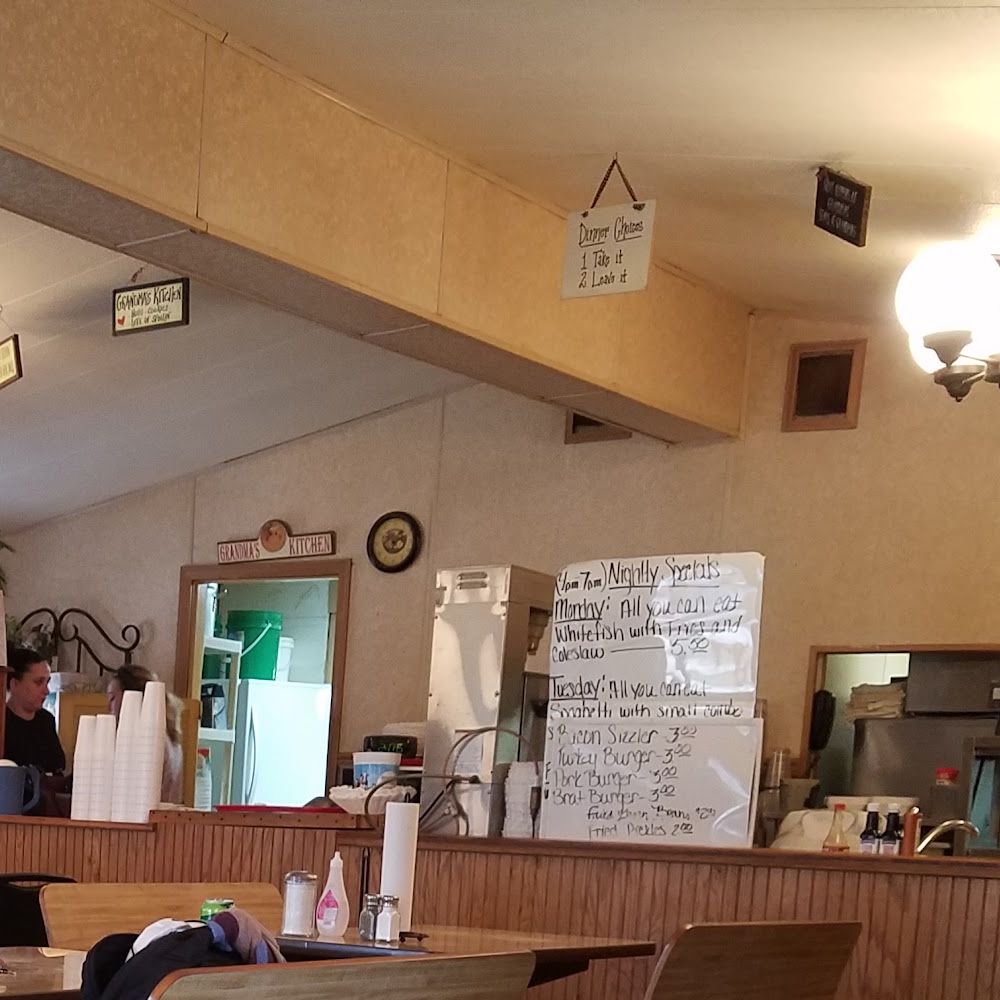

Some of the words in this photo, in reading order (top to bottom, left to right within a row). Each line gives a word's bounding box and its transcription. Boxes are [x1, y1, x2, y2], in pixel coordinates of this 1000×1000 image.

[579, 222, 609, 245] Dinner
[614, 216, 643, 241] Choices
[581, 252, 587, 270] 1
[593, 249, 610, 267] Take
[616, 249, 623, 264] it
[579, 271, 587, 288] 2
[592, 271, 615, 287] Leave
[620, 268, 627, 283] it
[220, 542, 260, 562] GRANDMA'S
[289, 535, 330, 555] KITCHEN
[608, 559, 659, 594] Nightly
[665, 556, 720, 587] Specials
[621, 595, 641, 618] All
[646, 600, 677, 619] you
[677, 596, 705, 614] can
[713, 593, 742, 613] eat
[555, 620, 624, 643] Whitefish
[629, 618, 662, 639] with
[712, 615, 743, 634] and
[552, 645, 605, 662] Coleslaw
[609, 680, 627, 699] All
[631, 681, 658, 699] you
[660, 682, 681, 697] can
[620, 704, 650, 718] with
[657, 703, 697, 718] small
[608, 723, 659, 744] Sizzler
[554, 767, 582, 787] Pork
[553, 788, 585, 806] Brat
